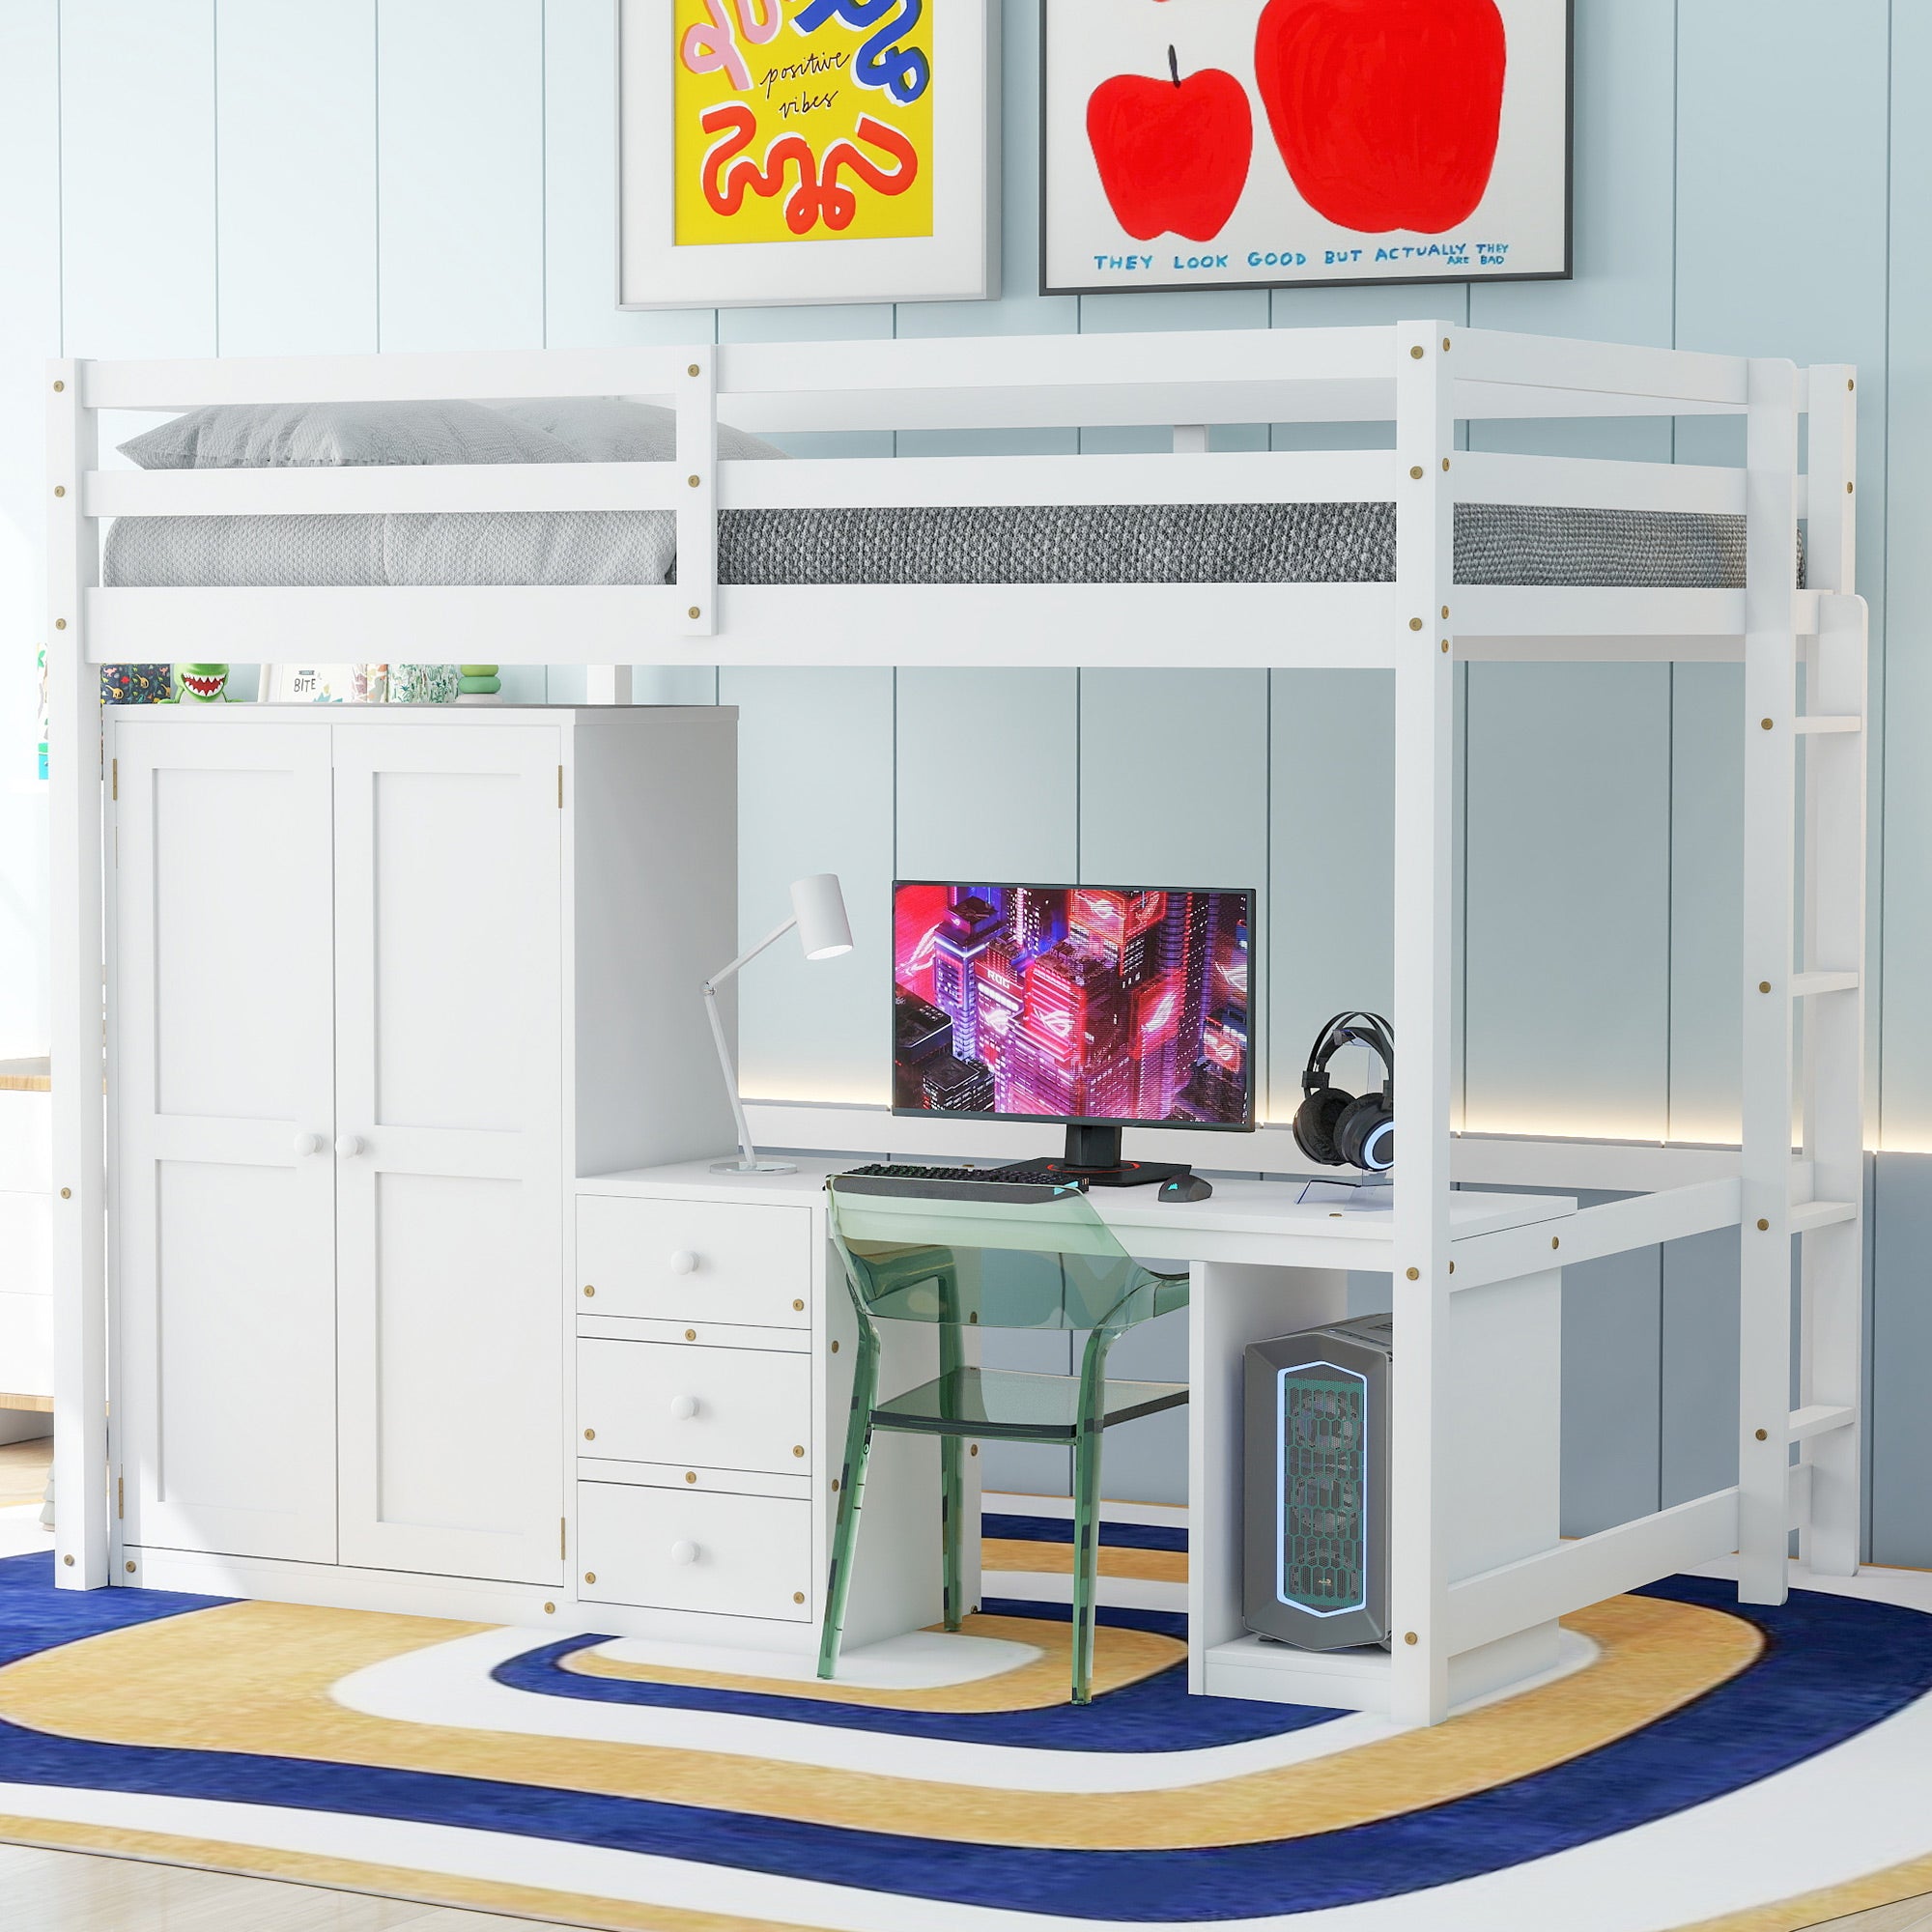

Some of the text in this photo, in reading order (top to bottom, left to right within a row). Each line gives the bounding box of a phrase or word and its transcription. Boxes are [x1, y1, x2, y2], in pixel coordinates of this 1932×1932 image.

[759, 51, 850, 99] positive
[779, 91, 838, 119] vibes
[1094, 243, 1509, 270] THEY LOOK GOOD BUT ACTUALLY THEY
[1447, 255, 1504, 265] ARE BAD
[293, 677, 316, 693] BITE
[987, 969, 1010, 990] ROG
